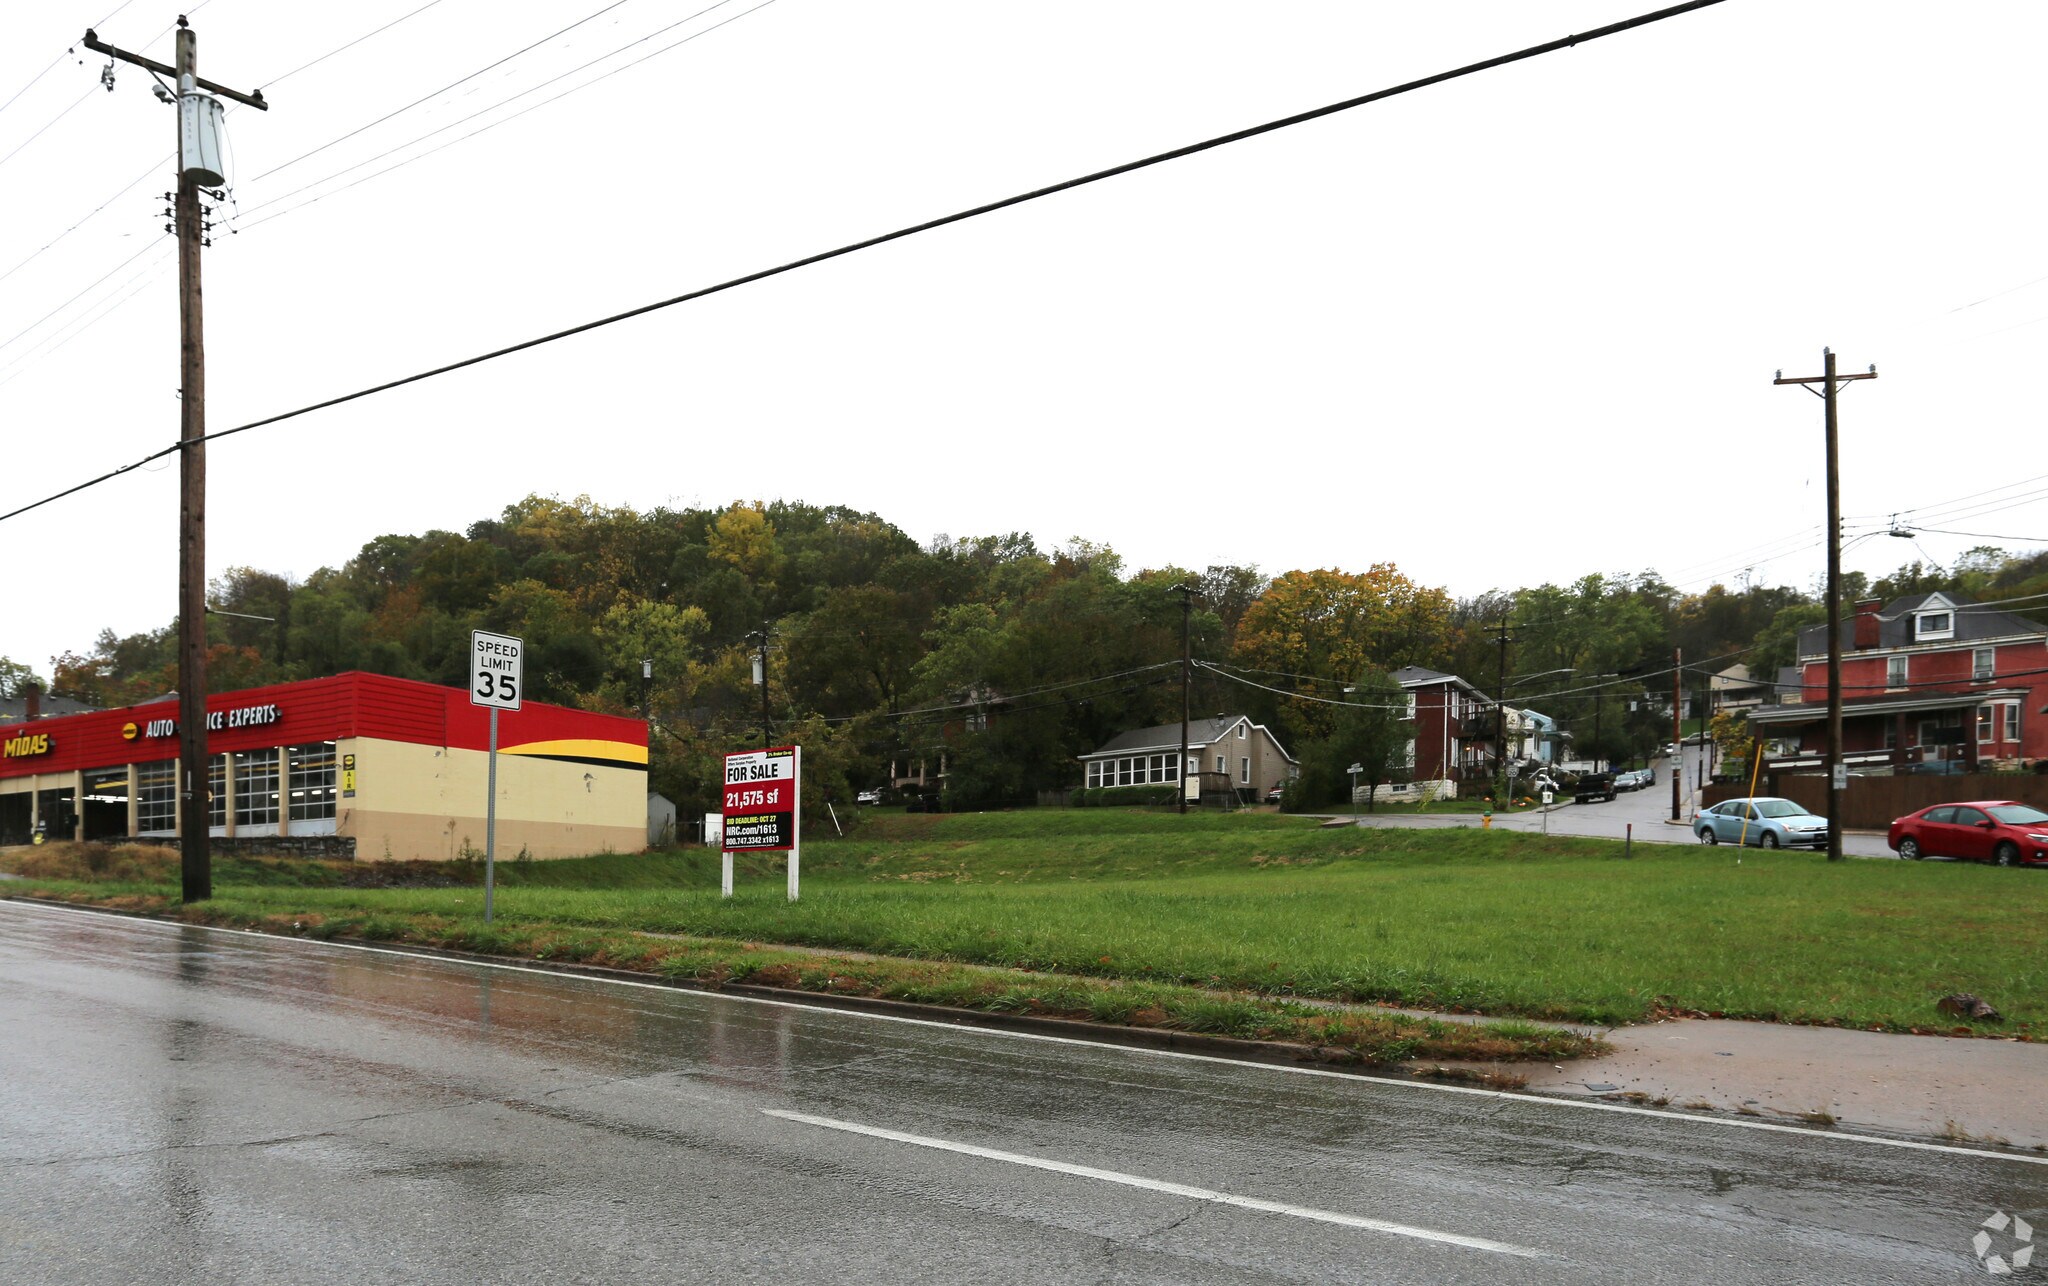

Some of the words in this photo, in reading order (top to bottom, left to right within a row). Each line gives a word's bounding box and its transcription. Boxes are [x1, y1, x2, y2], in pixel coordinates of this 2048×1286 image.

[477, 640, 518, 657] SPEED
[481, 656, 514, 672] LIMIT
[476, 671, 517, 702] 35
[145, 719, 174, 738] AUTO
[228, 704, 276, 728] EXPERTS
[3, 733, 49, 758] MIDAS
[727, 766, 747, 782] FOR
[750, 763, 778, 780] SALE
[726, 790, 764, 809] 21,575
[766, 788, 779, 804] sf
[735, 816, 759, 824] DEADLINE:
[726, 824, 777, 836] NRC.com/1613
[726, 836, 762, 845] 800.747.3342
[762, 835, 780, 844] x1613
